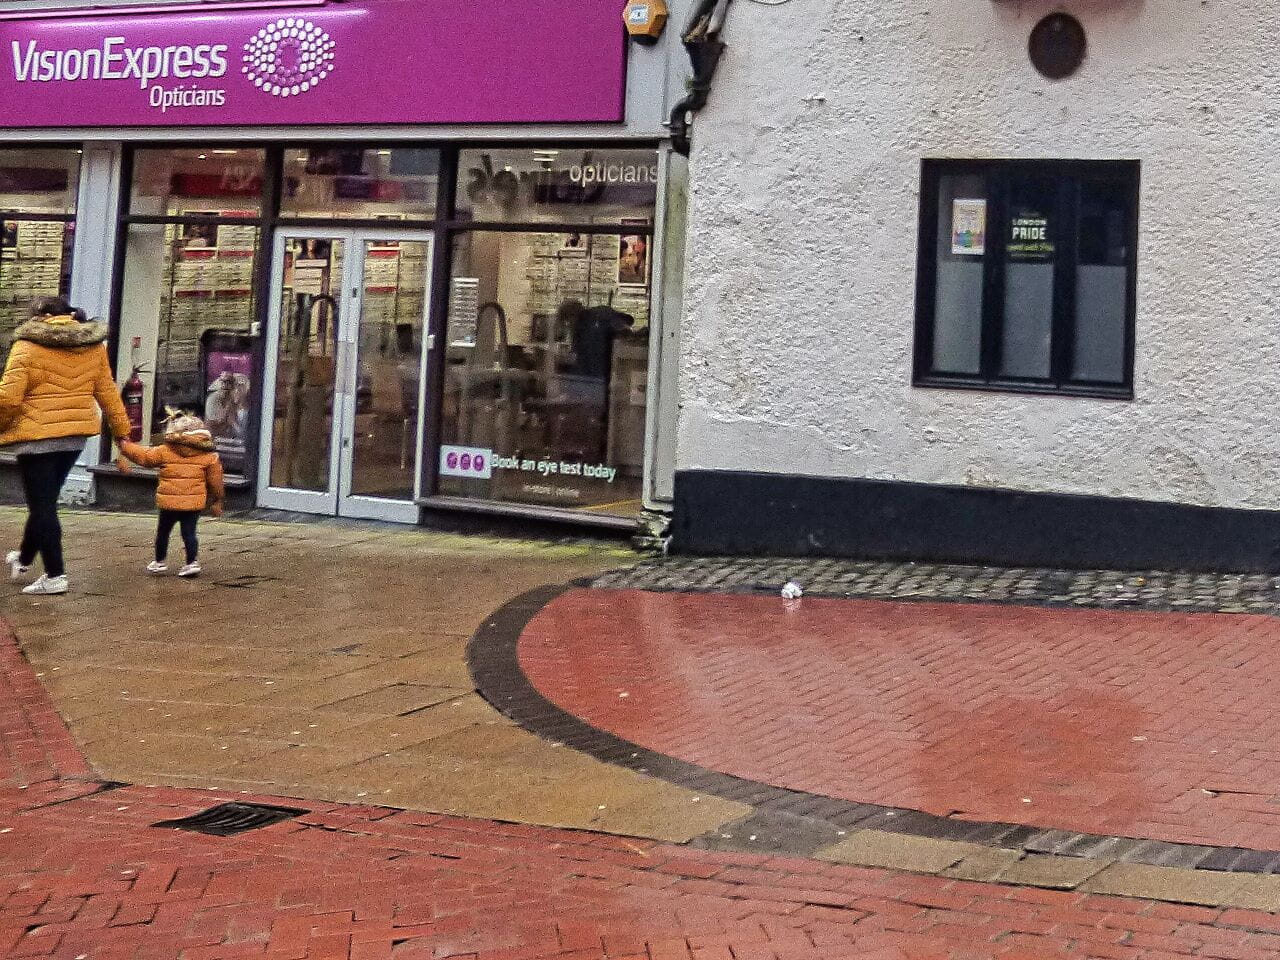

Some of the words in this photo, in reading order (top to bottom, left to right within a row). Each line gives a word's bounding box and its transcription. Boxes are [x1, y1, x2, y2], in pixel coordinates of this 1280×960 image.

[11, 36, 229, 89] VisionExpress
[149, 85, 226, 113] Opticians
[569, 161, 658, 188] opticians
[1011, 227, 1047, 240] PRIDE
[491, 453, 519, 468] Book
[521, 459, 536, 472] an
[537, 461, 558, 476] eye
[559, 461, 582, 476] test
[583, 463, 617, 483] today
